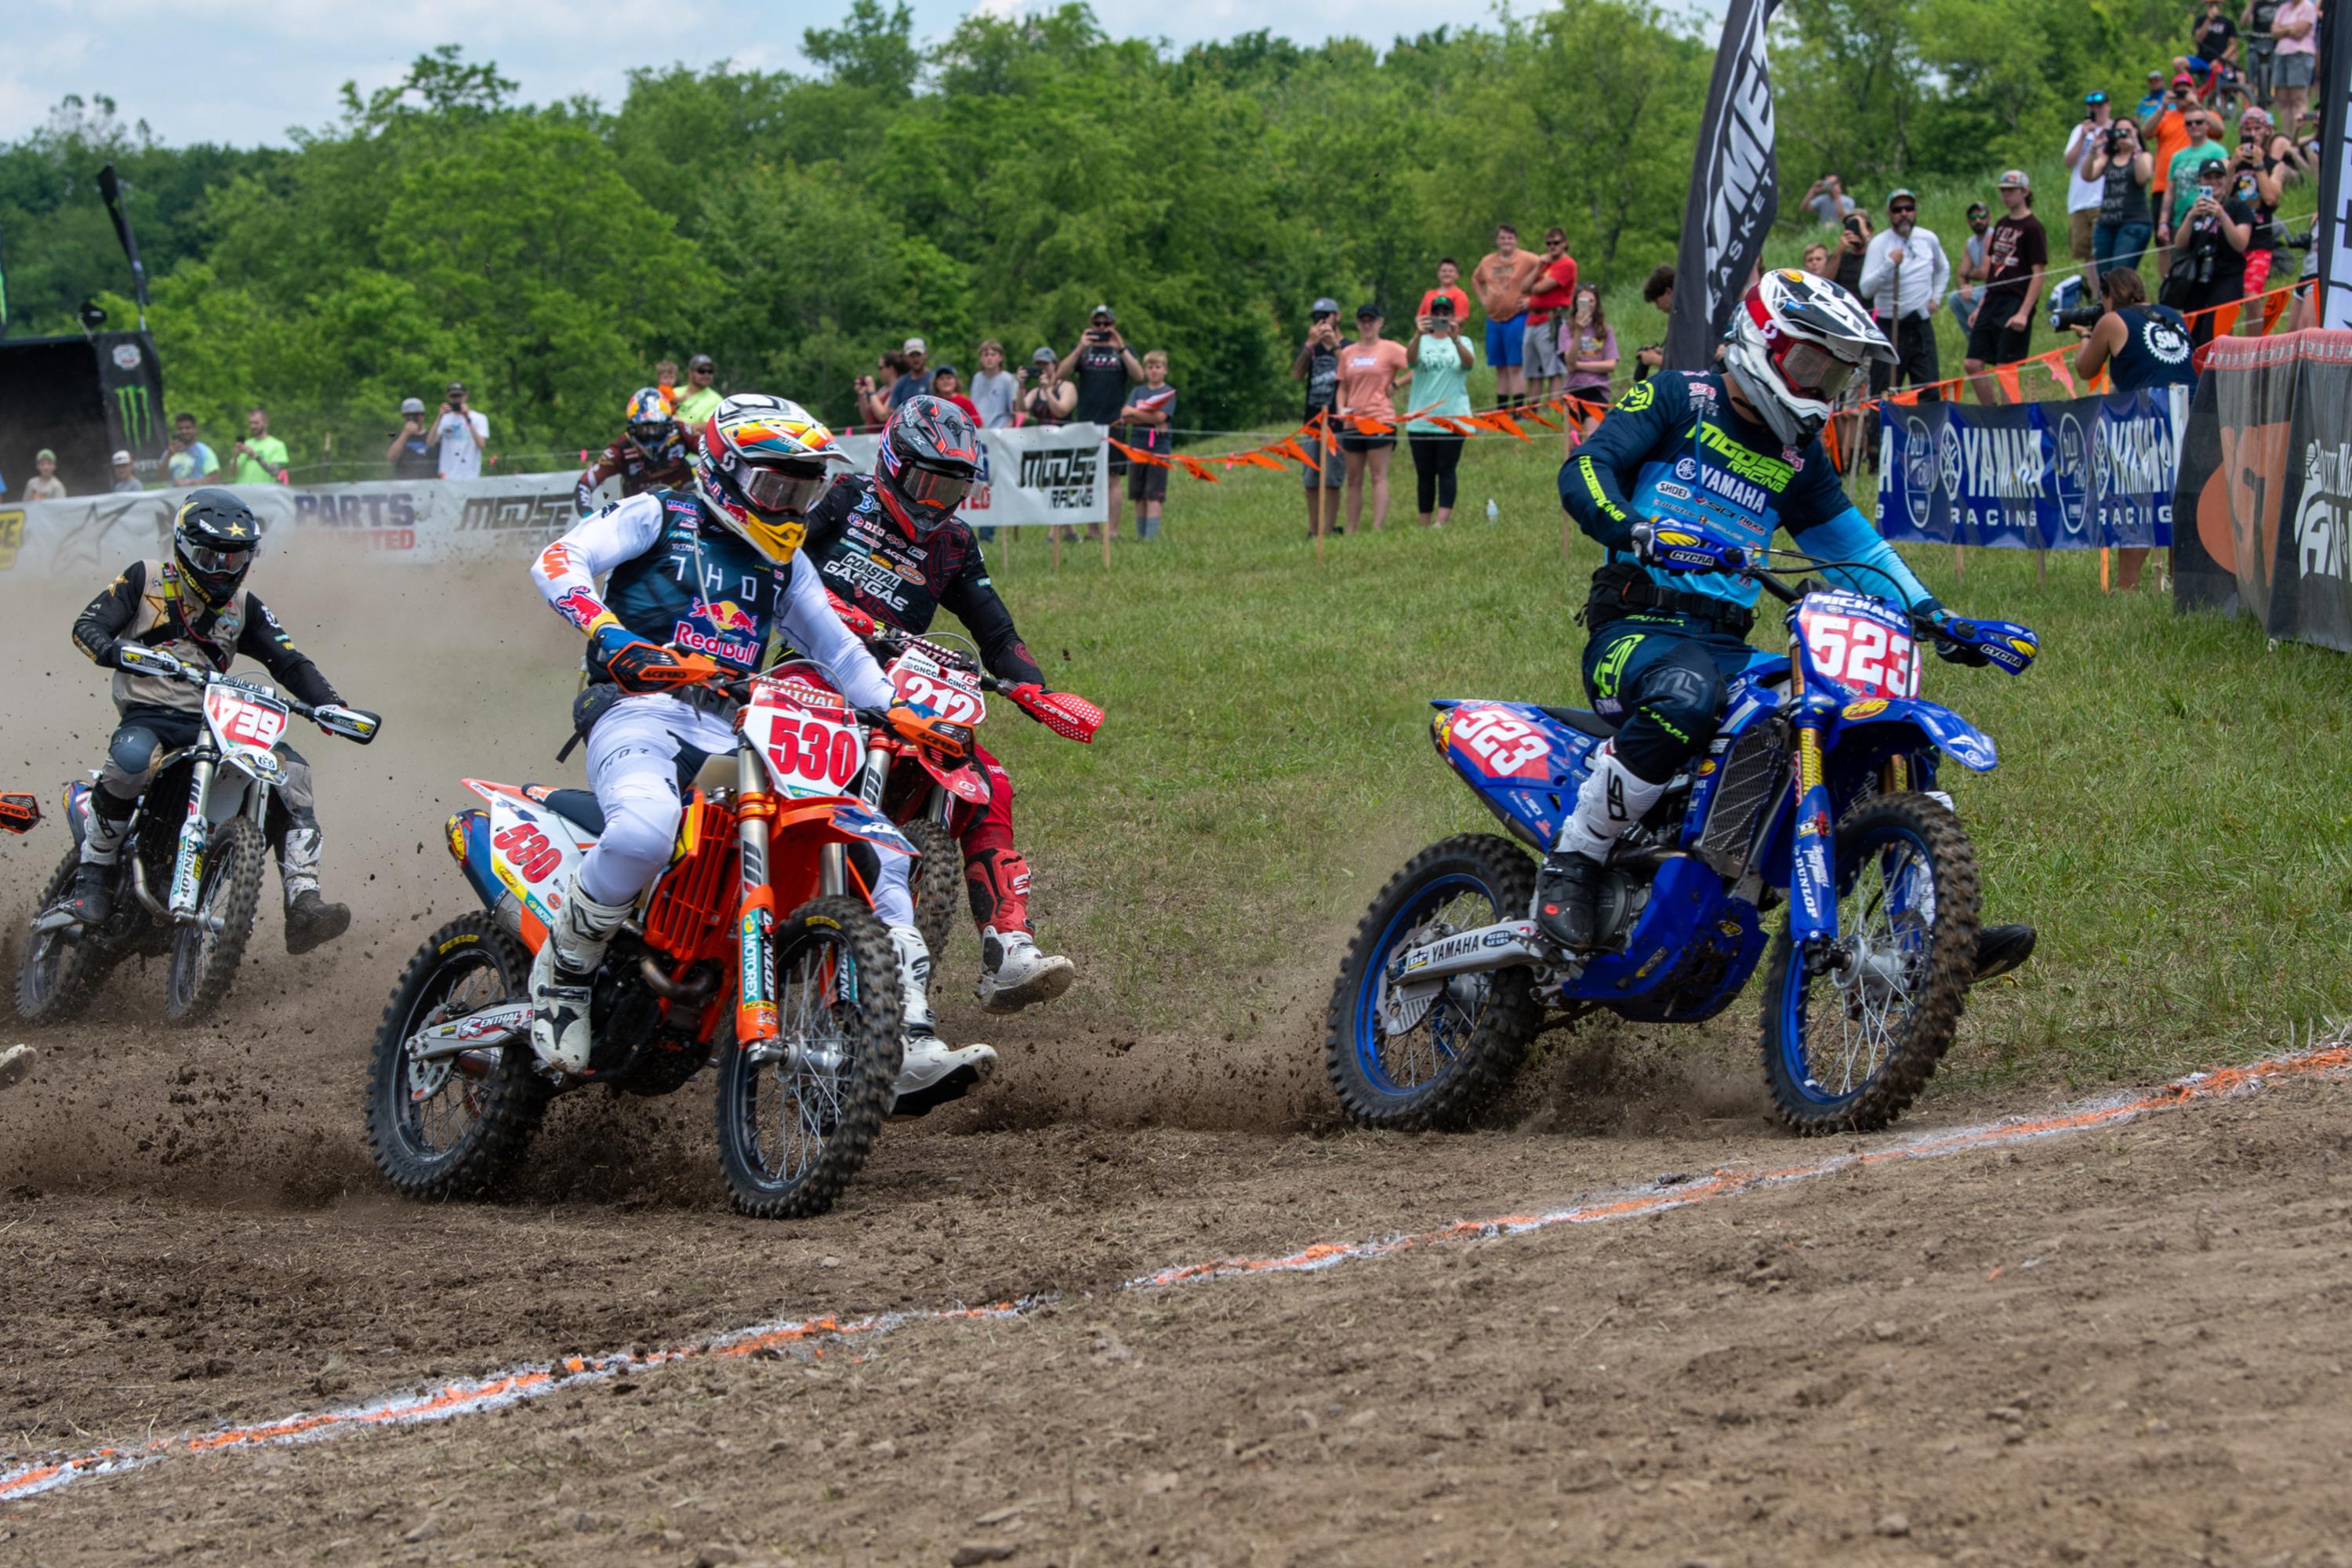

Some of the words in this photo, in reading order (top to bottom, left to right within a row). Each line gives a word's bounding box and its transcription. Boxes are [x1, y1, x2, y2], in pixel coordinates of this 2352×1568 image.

[1684, 420, 1796, 483] MOOSE
[1962, 426, 2046, 499] YAMAHA
[1048, 488, 1094, 508] RACING
[1658, 482, 1689, 499] SHOEI
[1700, 463, 1766, 514] YAMAHA
[1726, 458, 1787, 494] RACING
[294, 492, 416, 528] PARTS
[1950, 507, 2038, 527] RACING
[2097, 504, 2173, 526] RACING
[543, 541, 572, 582] KTM
[842, 554, 902, 590] COASTAL
[1670, 550, 1715, 566] CYCRA
[823, 560, 909, 612] GASGAS
[1809, 593, 1907, 628] MICHAEL
[673, 620, 720, 657] Red
[720, 641, 761, 666] Bull
[1808, 614, 1920, 697] 523
[1980, 644, 2023, 666] CYCRA
[905, 676, 975, 723] 212
[768, 714, 858, 788] 530
[1453, 709, 1551, 776] 523
[180, 837, 196, 898] DUNLOP
[492, 822, 563, 884] 530
[1795, 857, 1818, 918] DUNLOP
[743, 934, 758, 1000] MOTOREX
[763, 911, 775, 1002] DNLOP
[1432, 935, 1479, 964] YAMAHA
[458, 1009, 523, 1040] RENTHAL
